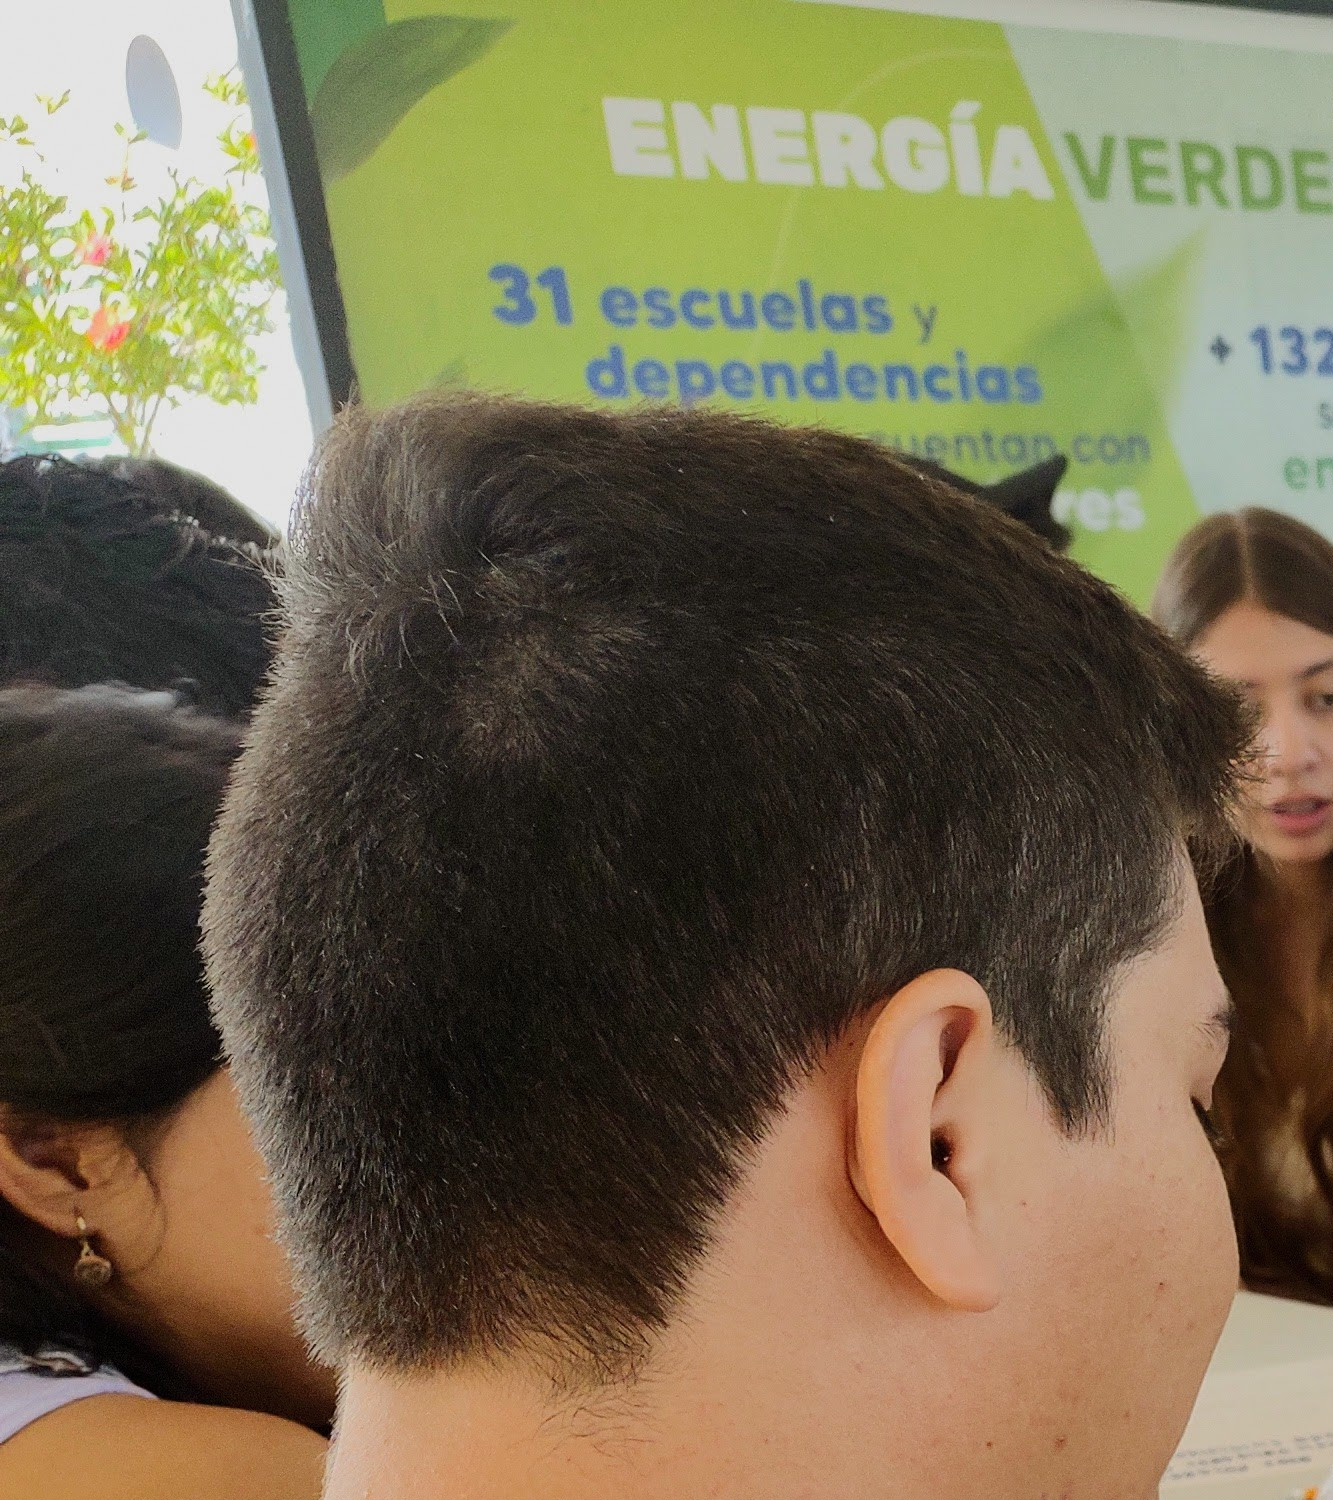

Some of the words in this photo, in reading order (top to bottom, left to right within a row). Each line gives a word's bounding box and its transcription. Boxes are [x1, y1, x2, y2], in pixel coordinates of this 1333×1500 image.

[601, 97, 1055, 201] ENERGÍA
[487, 262, 574, 327] 31
[600, 278, 895, 335] escuelas
[914, 302, 938, 346] y
[585, 344, 1044, 408] dependencias
[1071, 432, 1150, 466] con
[1050, 488, 1146, 532] res
